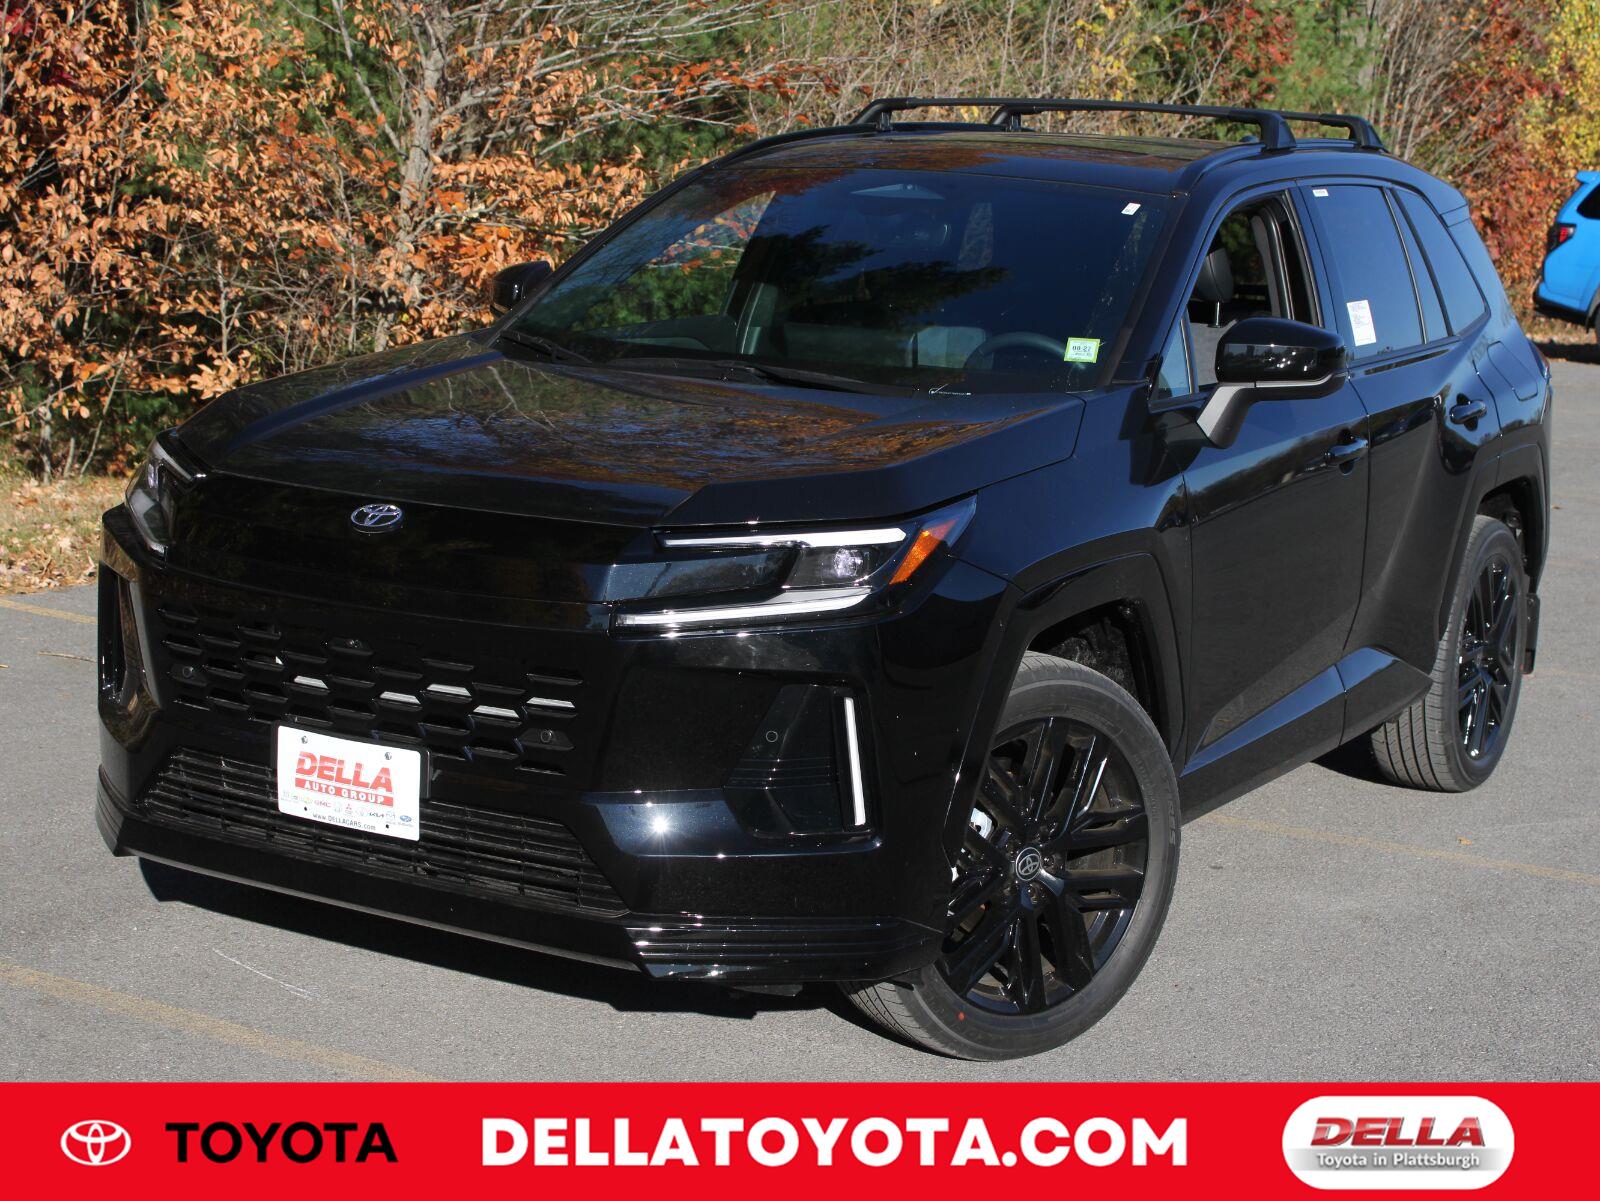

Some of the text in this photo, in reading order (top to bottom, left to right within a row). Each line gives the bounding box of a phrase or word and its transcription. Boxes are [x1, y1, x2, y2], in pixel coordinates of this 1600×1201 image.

[295, 751, 393, 793] DELLA
[304, 780, 384, 804] AUTO GROUP
[312, 812, 377, 831] www.DELLACARS.com
